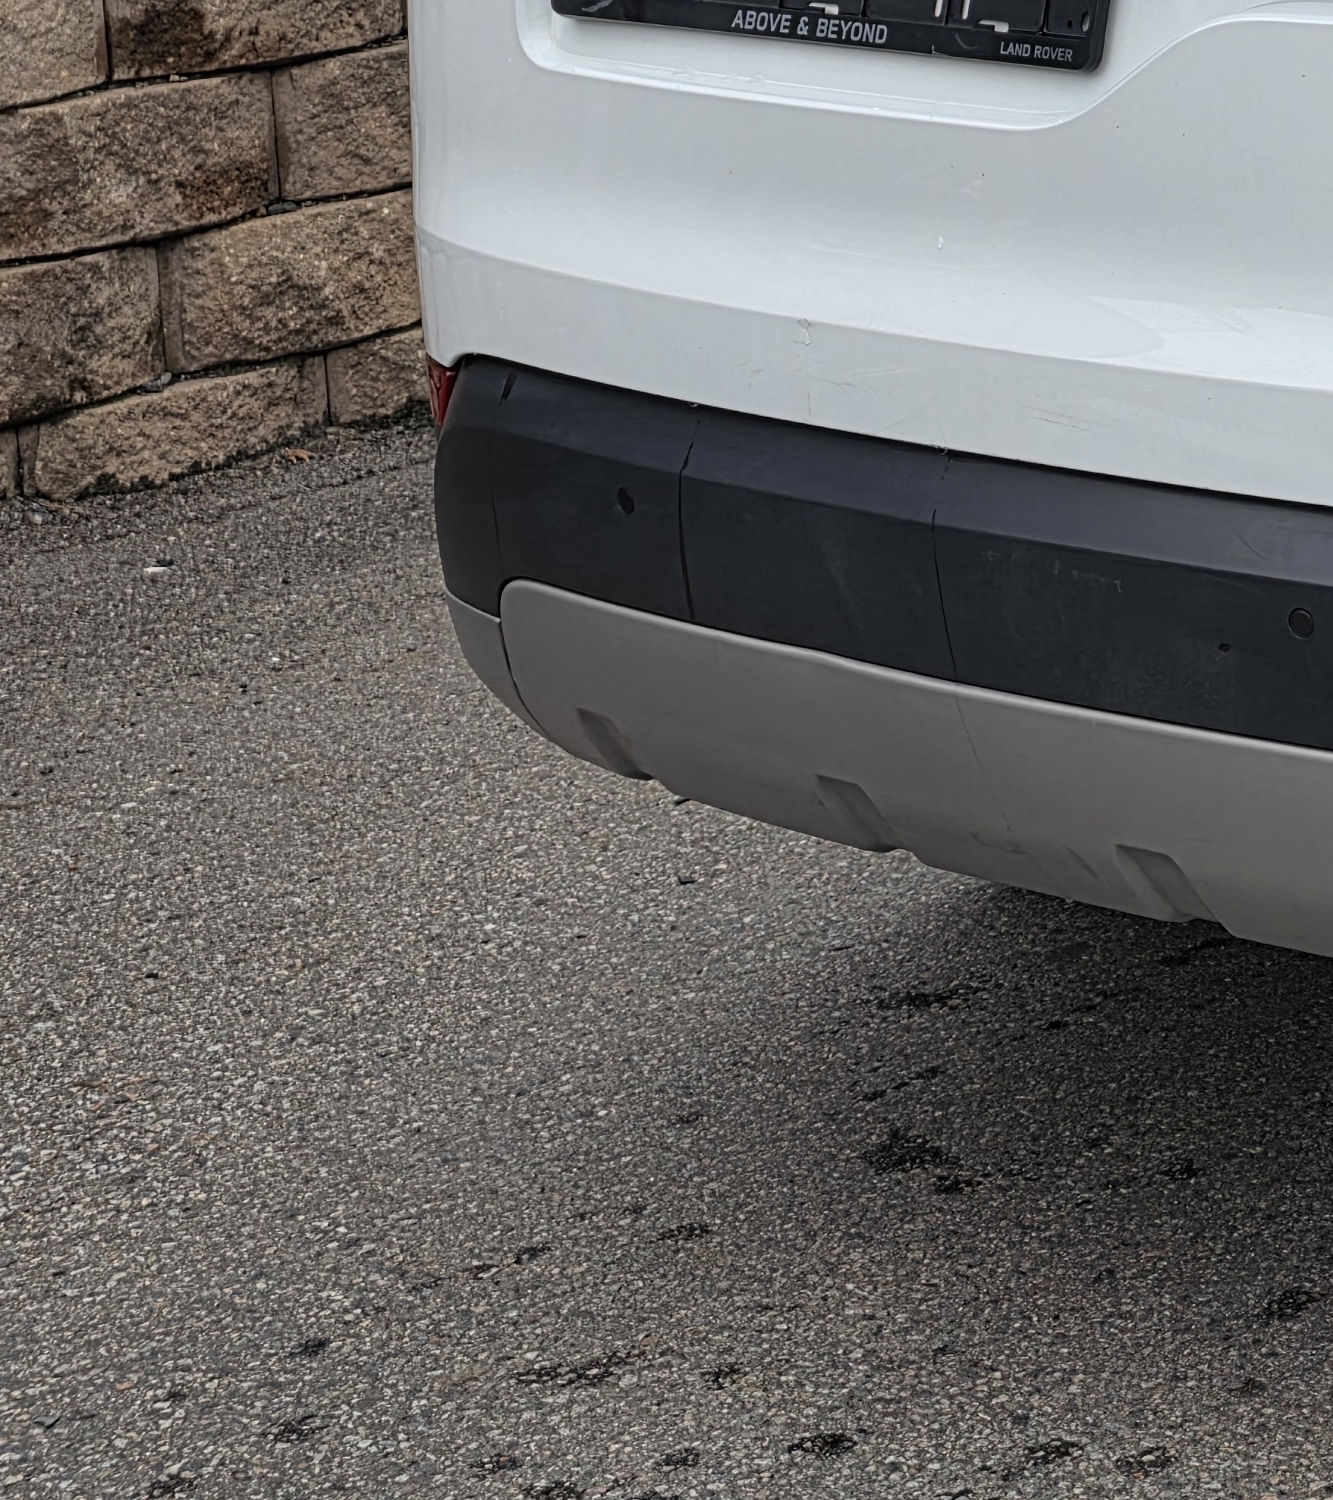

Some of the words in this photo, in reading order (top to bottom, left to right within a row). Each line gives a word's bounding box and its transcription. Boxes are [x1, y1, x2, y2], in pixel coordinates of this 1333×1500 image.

[731, 9, 792, 34] ABOVE
[796, 16, 809, 36] &
[815, 18, 888, 45] BEYOND
[1000, 41, 1031, 58] LAND
[1034, 45, 1073, 62] ROVER
